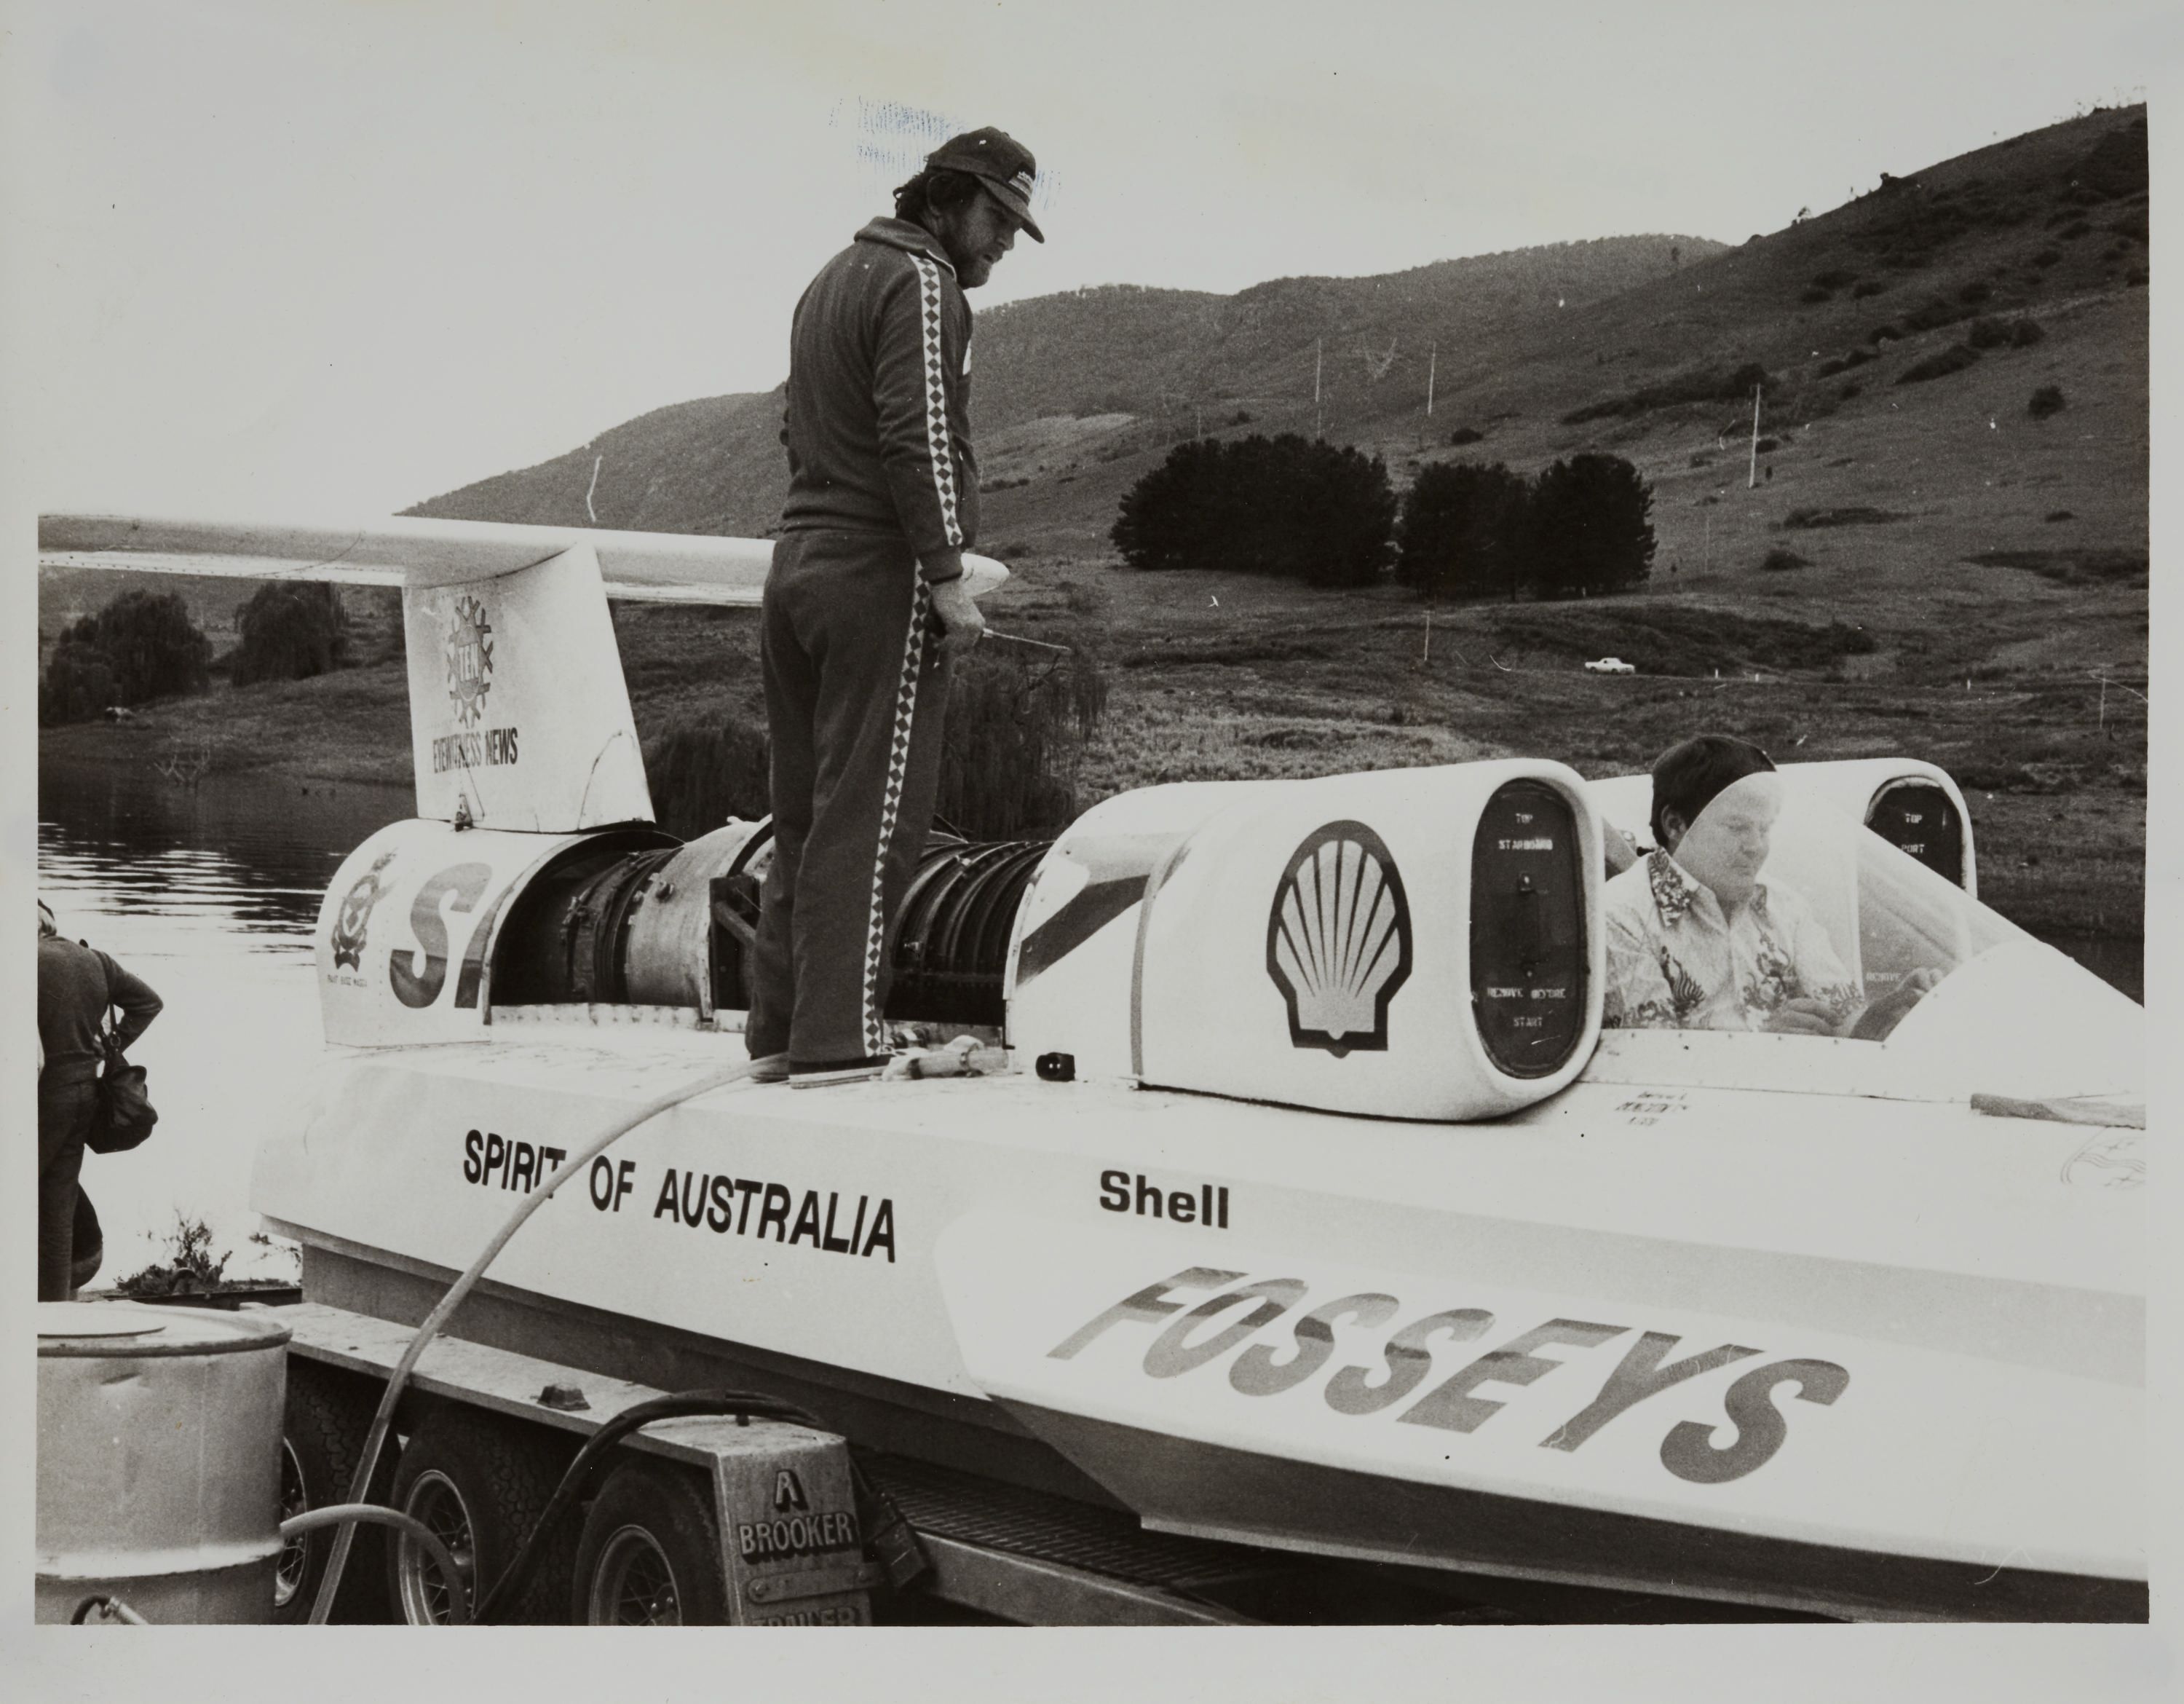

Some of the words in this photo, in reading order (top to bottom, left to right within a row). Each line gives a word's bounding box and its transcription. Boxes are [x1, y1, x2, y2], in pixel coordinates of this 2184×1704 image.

[433, 731, 482, 773] EYEWITNESS
[485, 727, 518, 765] NEWS
[1515, 813, 1534, 824] TOP
[1904, 813, 1923, 824] TOP
[1901, 844, 1926, 854] PORT
[1487, 987, 1524, 998] REMOVE
[1530, 987, 1567, 999] BEFORE
[1513, 1017, 1543, 1027] START
[463, 1129, 567, 1199] SPIRIT
[589, 1155, 636, 1212] OF
[653, 1168, 896, 1263] AUSTRALIA
[1099, 1169, 1230, 1229] Shell
[1045, 1265, 1851, 1485] FOSSEYS
[775, 1470, 800, 1506] A
[739, 1512, 853, 1555] BROOKER
